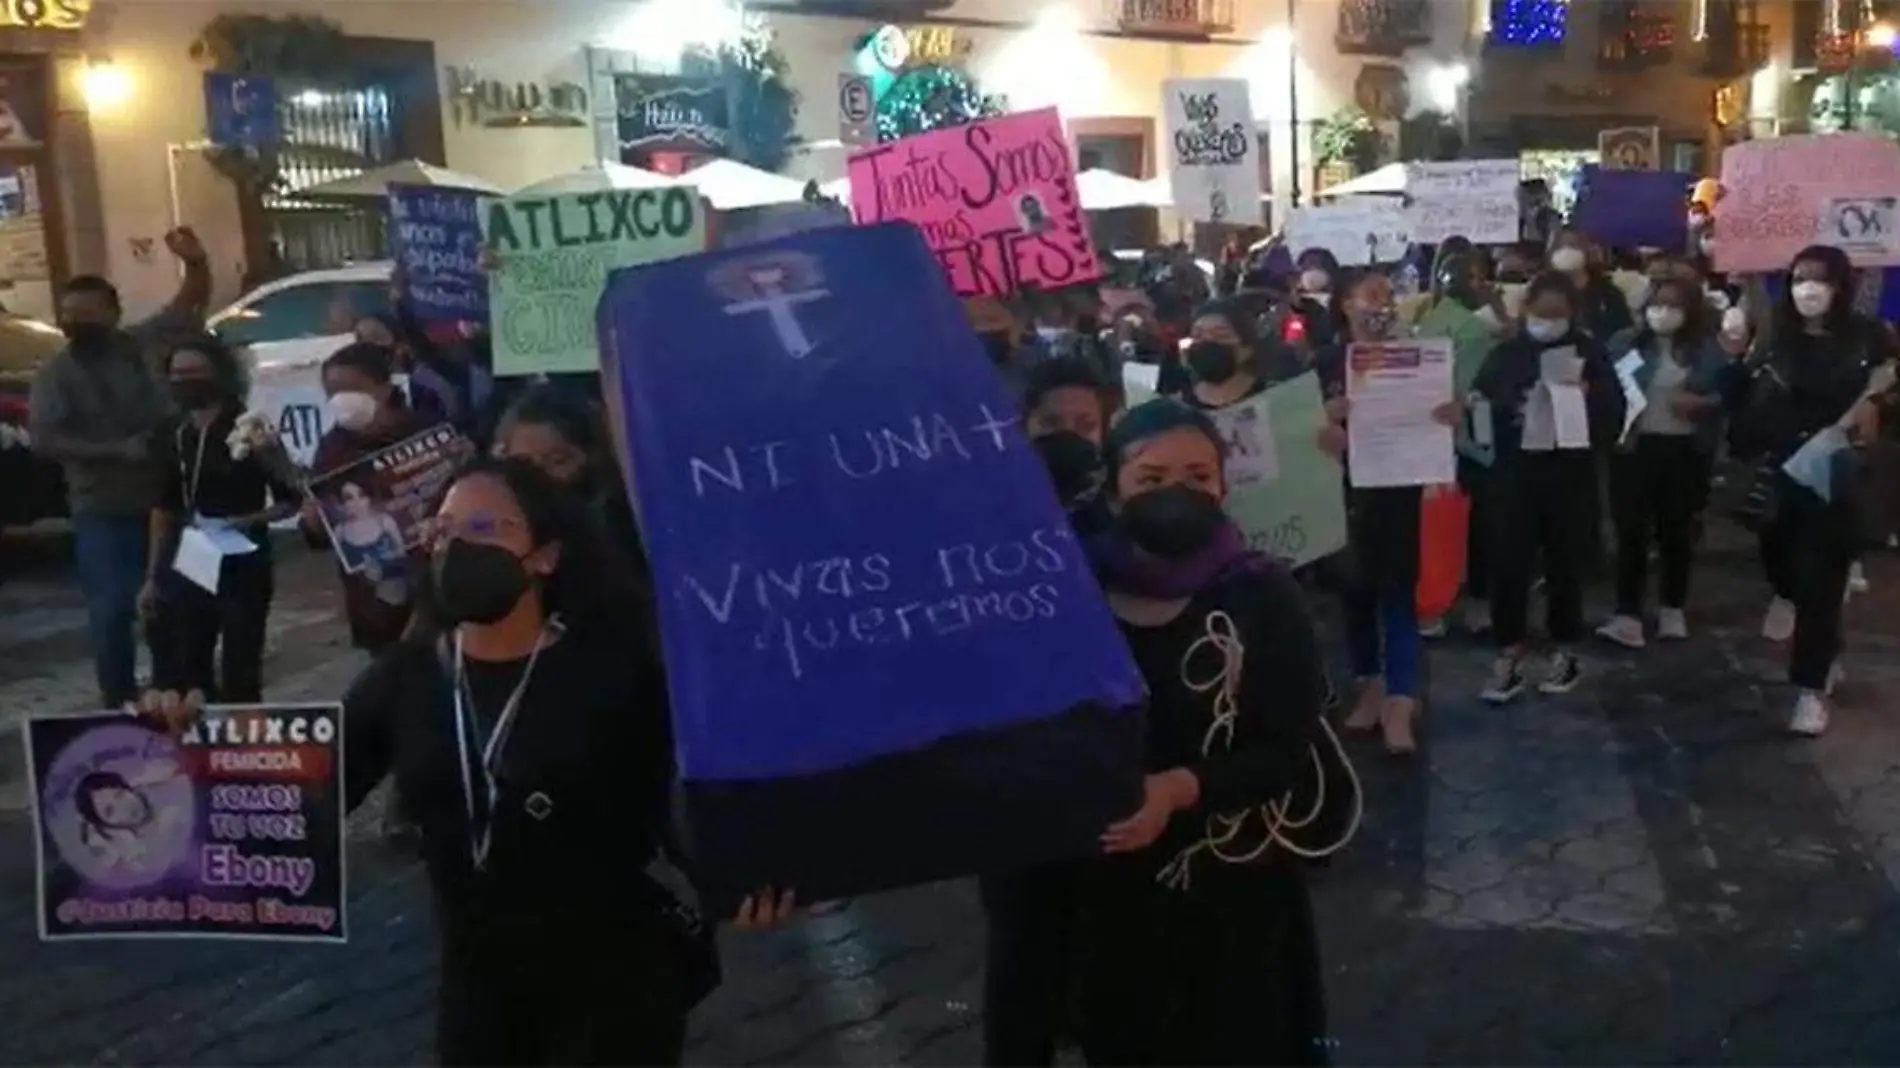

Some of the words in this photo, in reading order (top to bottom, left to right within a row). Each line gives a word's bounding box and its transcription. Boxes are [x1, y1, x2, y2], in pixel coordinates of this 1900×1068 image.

[487, 186, 695, 251] ATLIXCO
[689, 443, 796, 499] NI
[181, 716, 336, 745] ATLIXCO
[210, 784, 302, 811] SOMOS
[200, 843, 315, 896] Ebony
